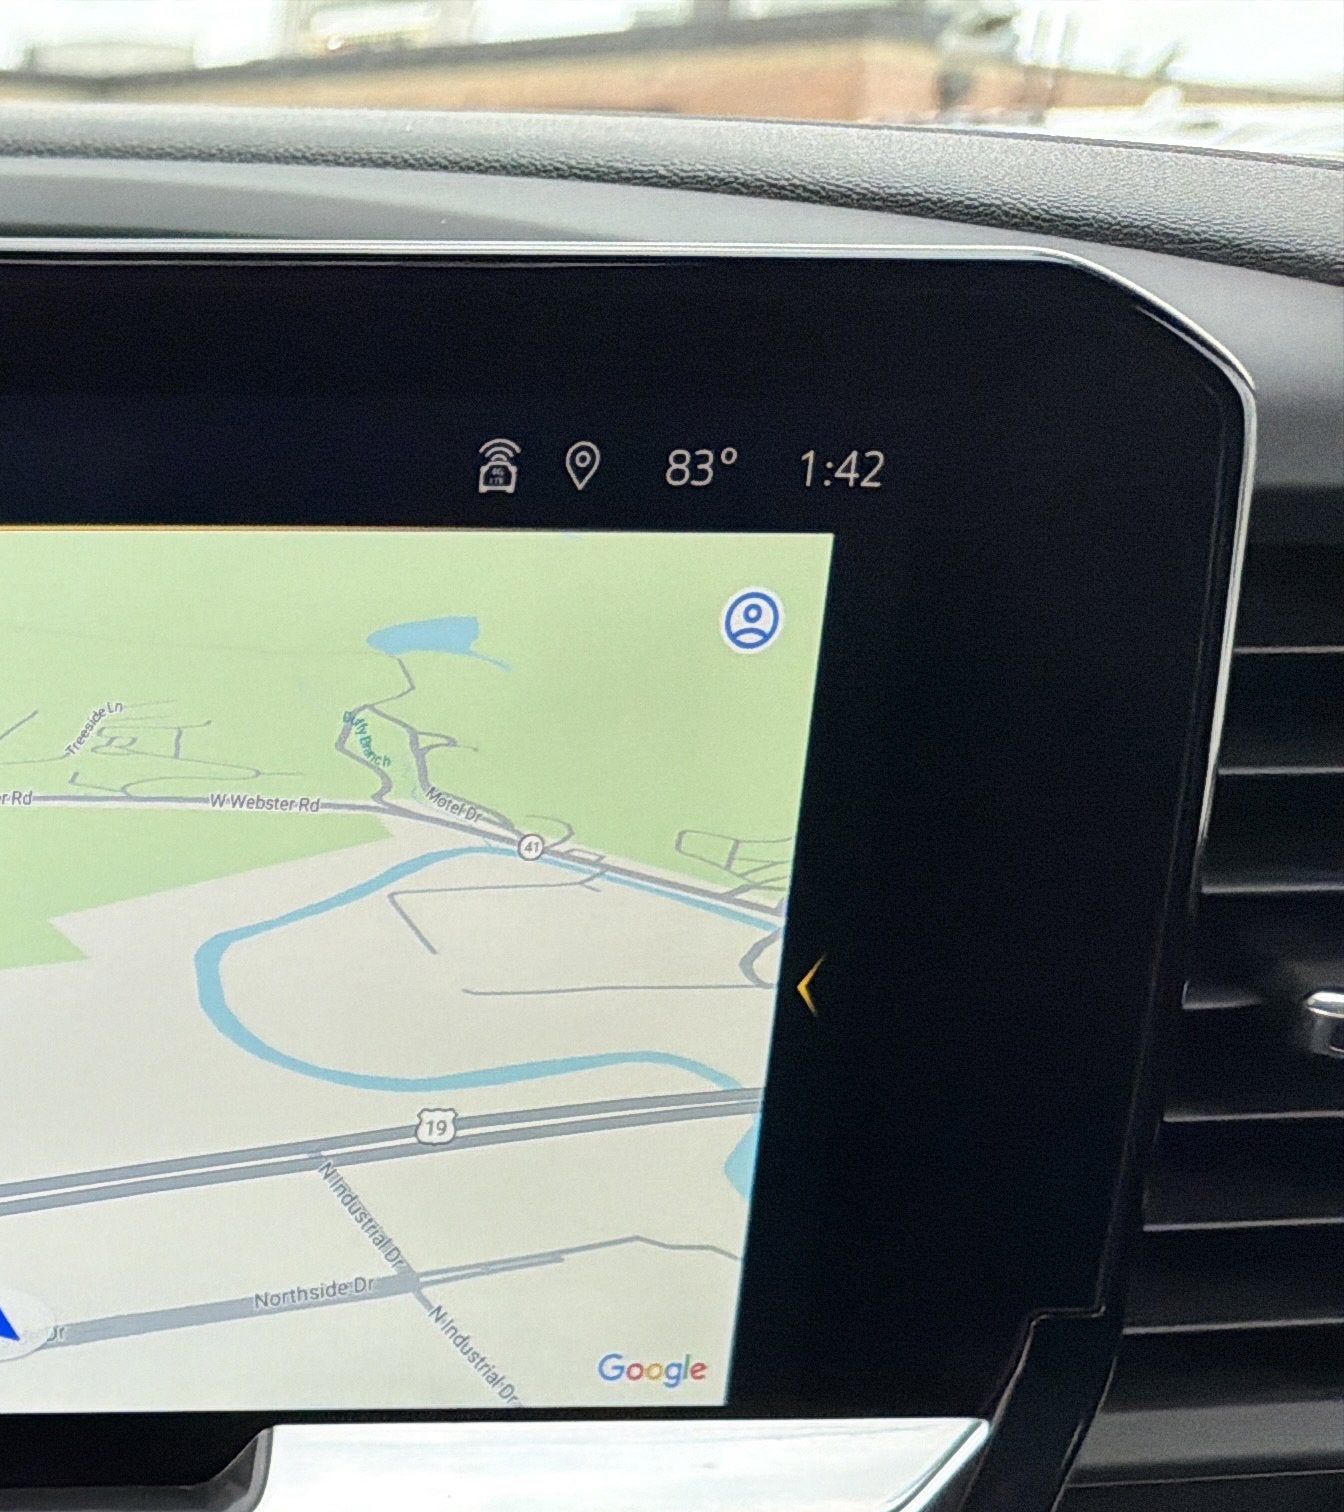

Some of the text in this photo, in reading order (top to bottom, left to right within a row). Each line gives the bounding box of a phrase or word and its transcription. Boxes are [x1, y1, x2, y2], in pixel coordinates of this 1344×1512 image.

[665, 447, 738, 487] 83°
[800, 450, 885, 488] 1:42
[65, 701, 123, 755] Treeside Ln
[359, 735, 392, 767] Branch
[11, 790, 33, 806] Rd
[209, 793, 321, 813] W Webster Rd
[425, 786, 483, 823] Motel Dr
[523, 841, 540, 853] 41
[425, 1119, 448, 1136] 19
[318, 1161, 403, 1269] N Industrial Dr
[254, 1276, 375, 1308] Northside Dr
[428, 1305, 520, 1405] N Industrial Dr
[598, 1354, 708, 1388] Google
